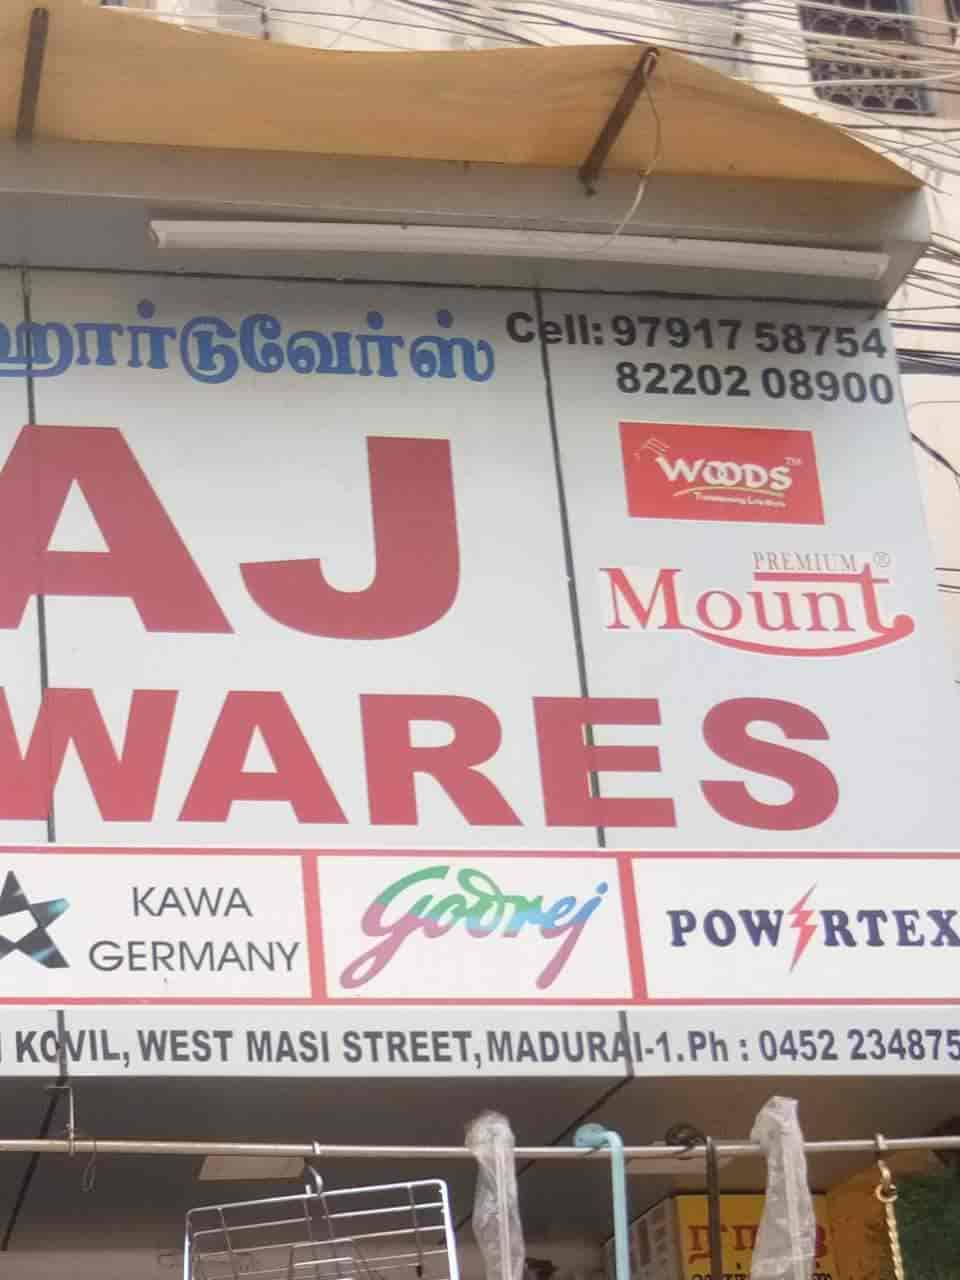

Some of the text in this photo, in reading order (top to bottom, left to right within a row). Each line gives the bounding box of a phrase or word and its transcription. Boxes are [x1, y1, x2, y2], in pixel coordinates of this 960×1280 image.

[612, 314, 742, 351] 97917
[754, 322, 887, 358] 58754
[616, 362, 894, 404] 82202 08900
[656, 456, 793, 491] WOODS
[752, 551, 857, 573] PREMIUM
[600, 563, 915, 658] Mount
[132, 887, 253, 917] KAWA
[339, 864, 609, 990] Godrej
[88, 940, 300, 972] GERMANY
[15, 1030, 130, 1067] KOVIL,
[137, 1030, 233, 1063] WEST
[246, 1030, 329, 1064] MASI
[759, 1029, 838, 1061] 0452
